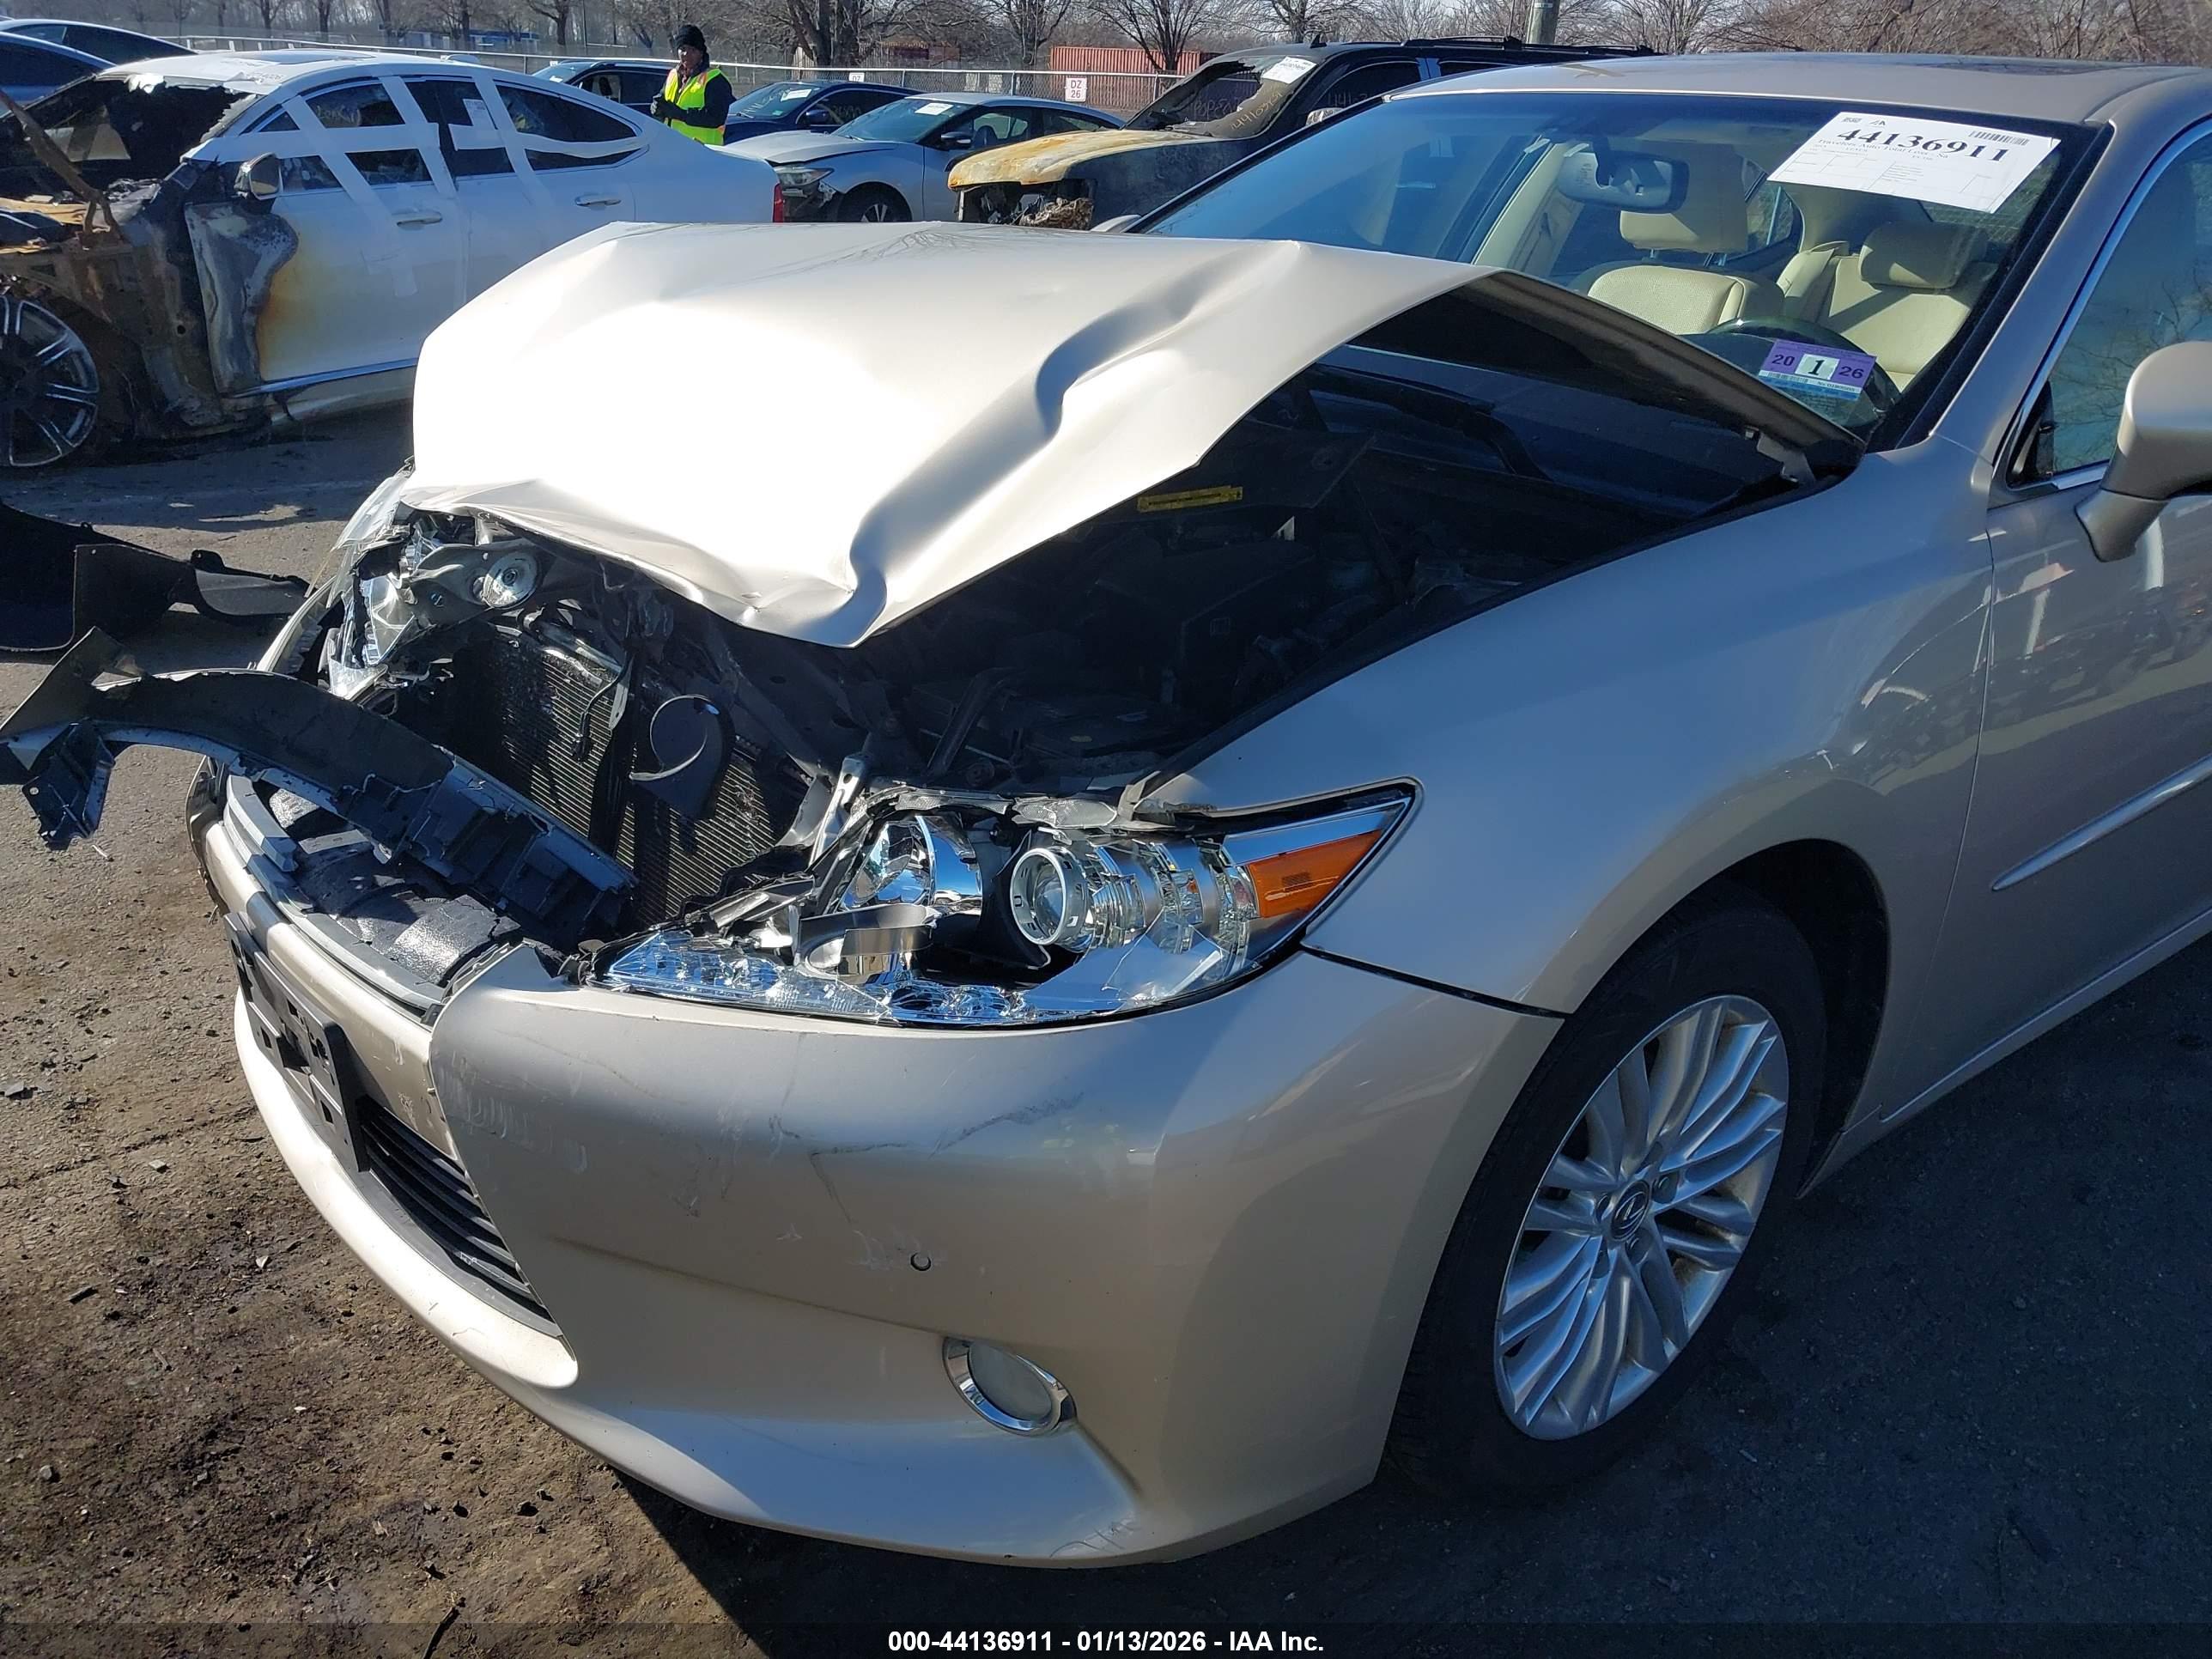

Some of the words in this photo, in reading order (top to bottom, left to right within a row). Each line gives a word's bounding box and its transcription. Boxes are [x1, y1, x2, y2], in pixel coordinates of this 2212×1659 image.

[1071, 89, 1081, 99] 26
[1836, 129, 2010, 162] 44136911
[1771, 354, 1796, 367] 20
[1808, 359, 1825, 376] 1
[1838, 366, 1865, 380] 26
